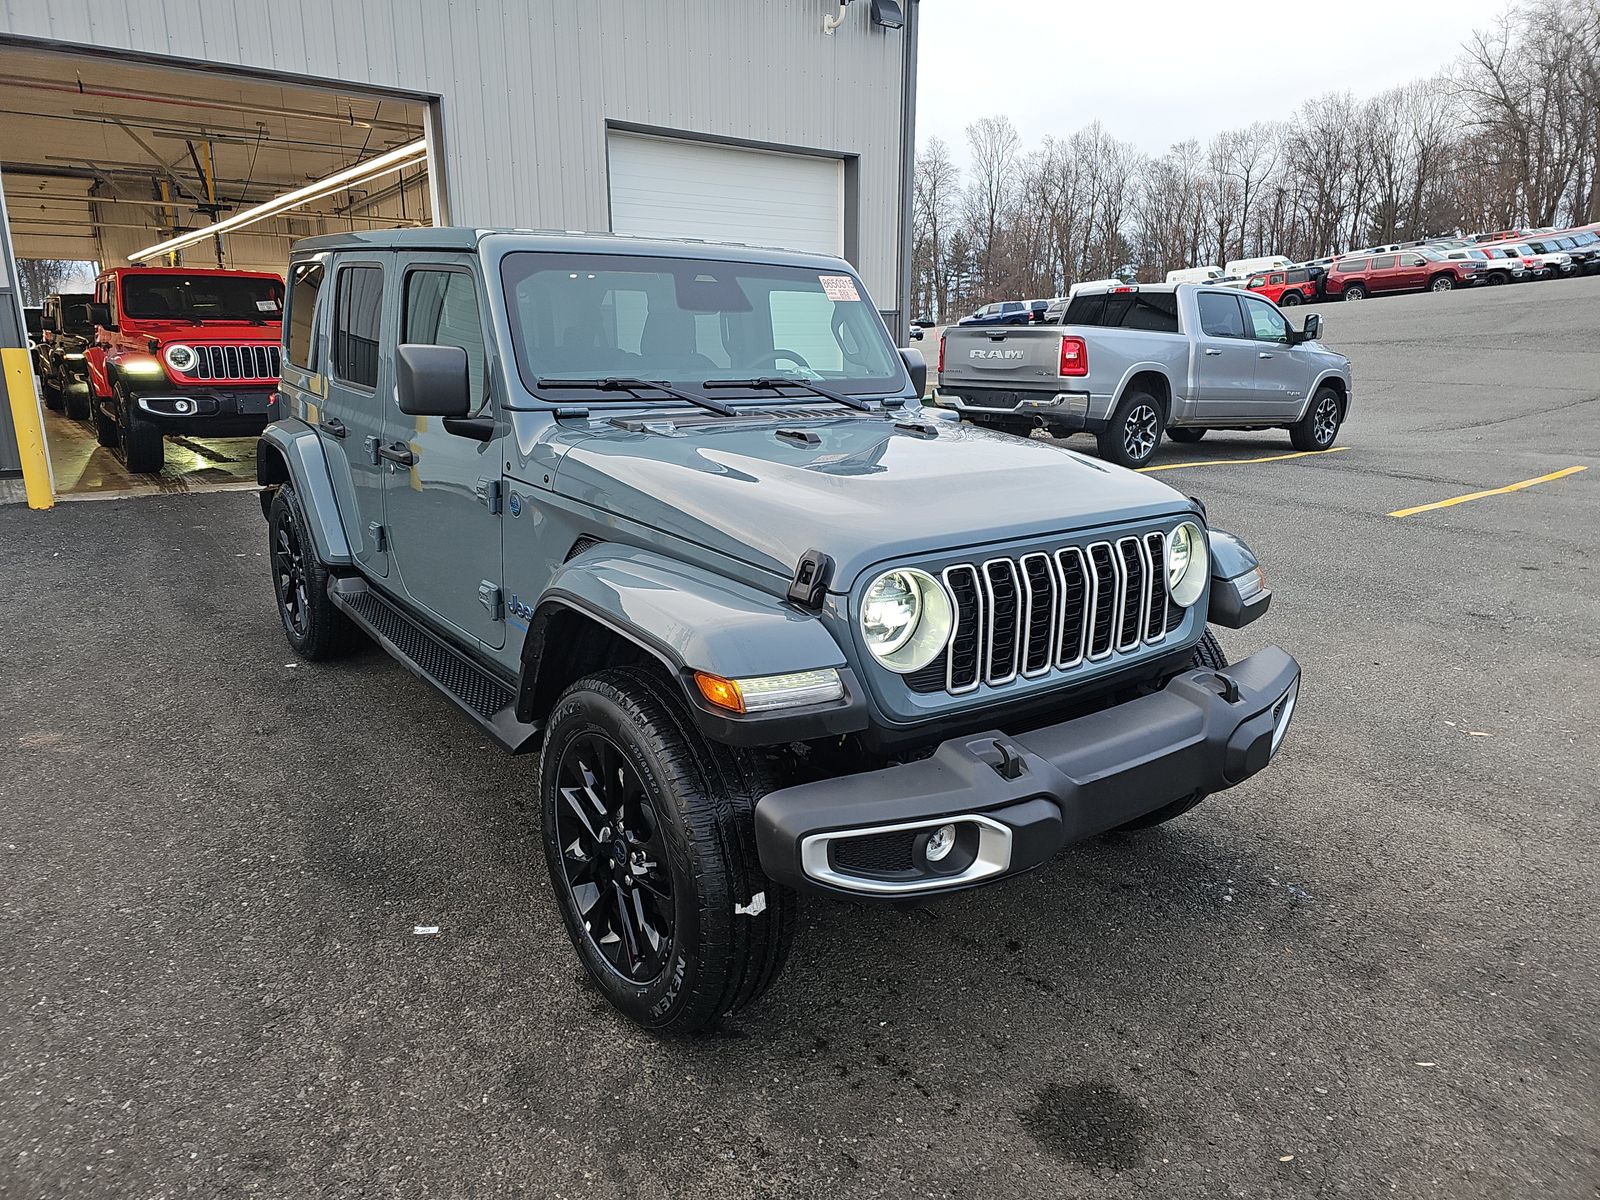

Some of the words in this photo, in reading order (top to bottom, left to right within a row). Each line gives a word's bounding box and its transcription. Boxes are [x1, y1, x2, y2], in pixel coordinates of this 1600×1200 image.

[969, 349, 1024, 360] RAM
[507, 592, 536, 622] Jee
[650, 955, 686, 1017] NEXEN
